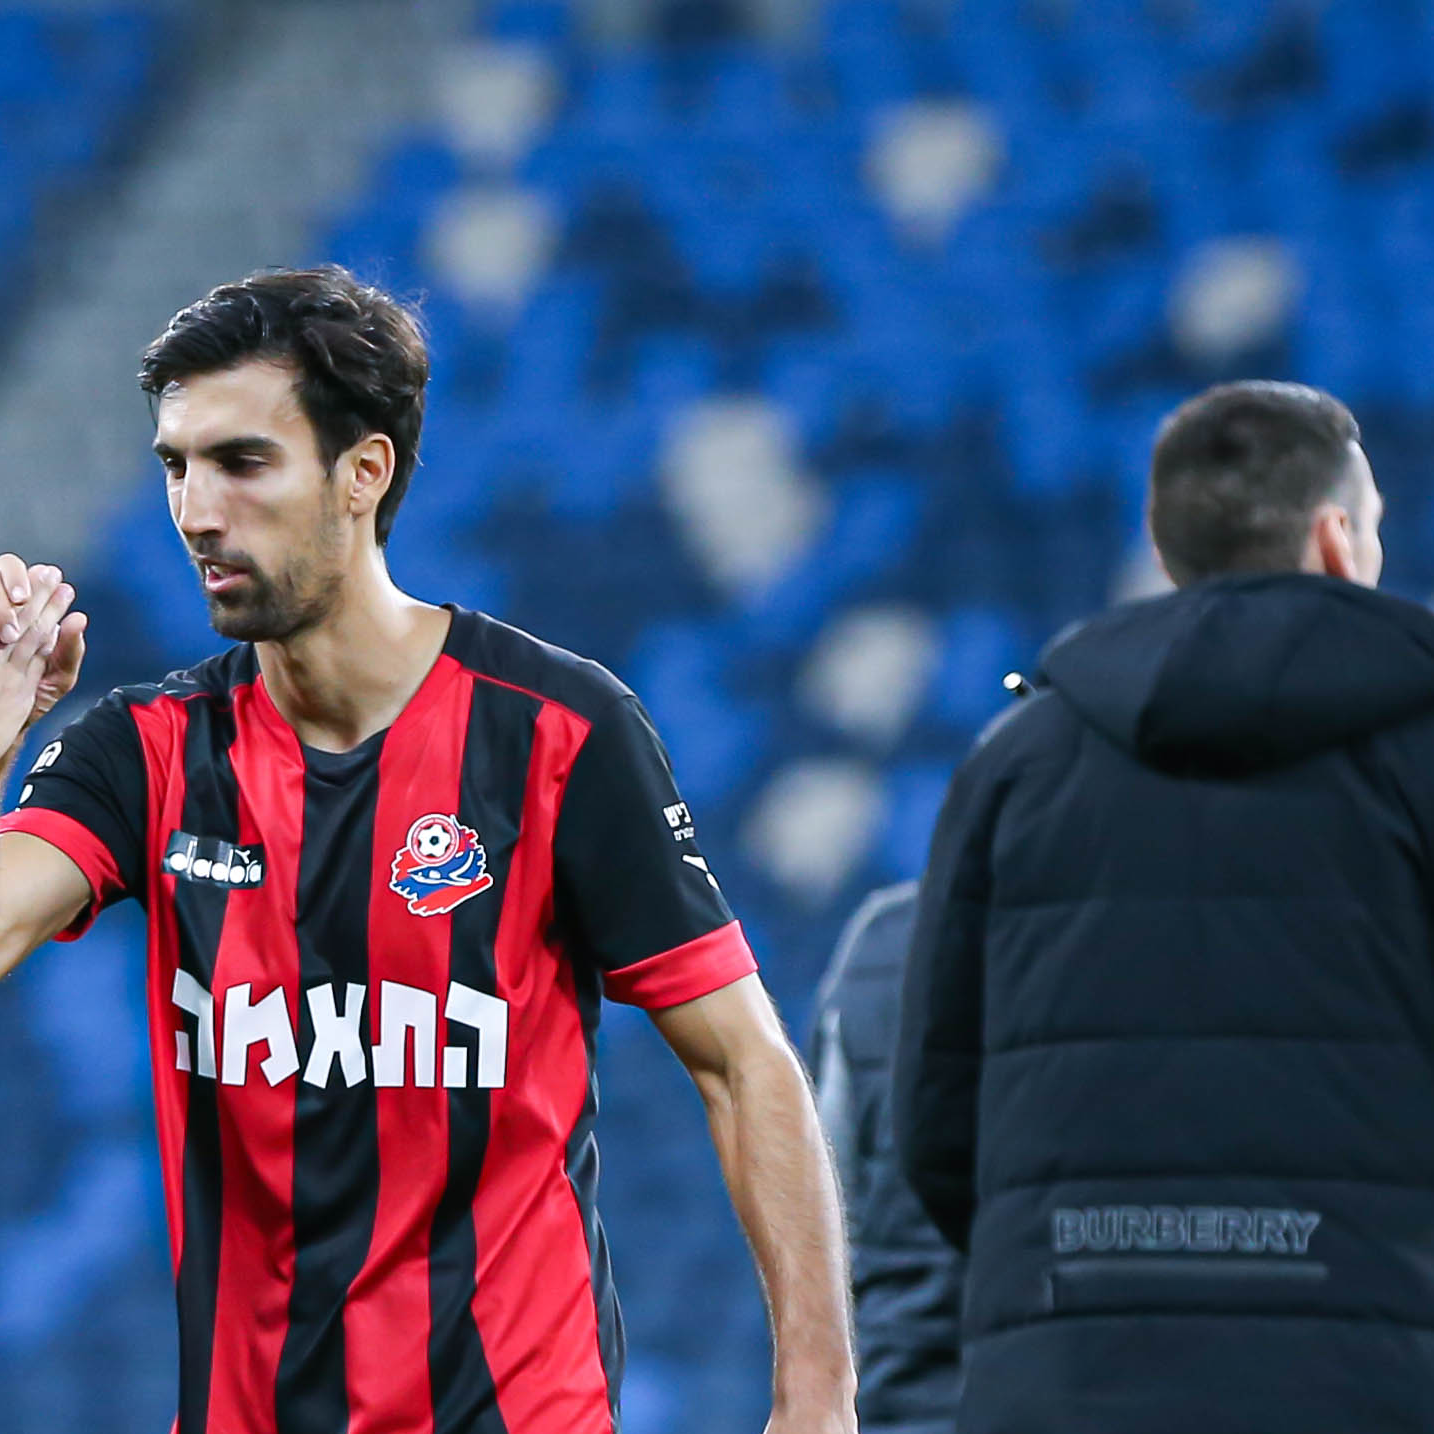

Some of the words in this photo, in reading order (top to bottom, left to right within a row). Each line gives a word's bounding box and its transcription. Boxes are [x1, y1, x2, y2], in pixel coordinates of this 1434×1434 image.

[168, 840, 263, 884] diadora
[172, 967, 509, 1089] התאמה
[1052, 1205, 1321, 1254] BURBERRY
